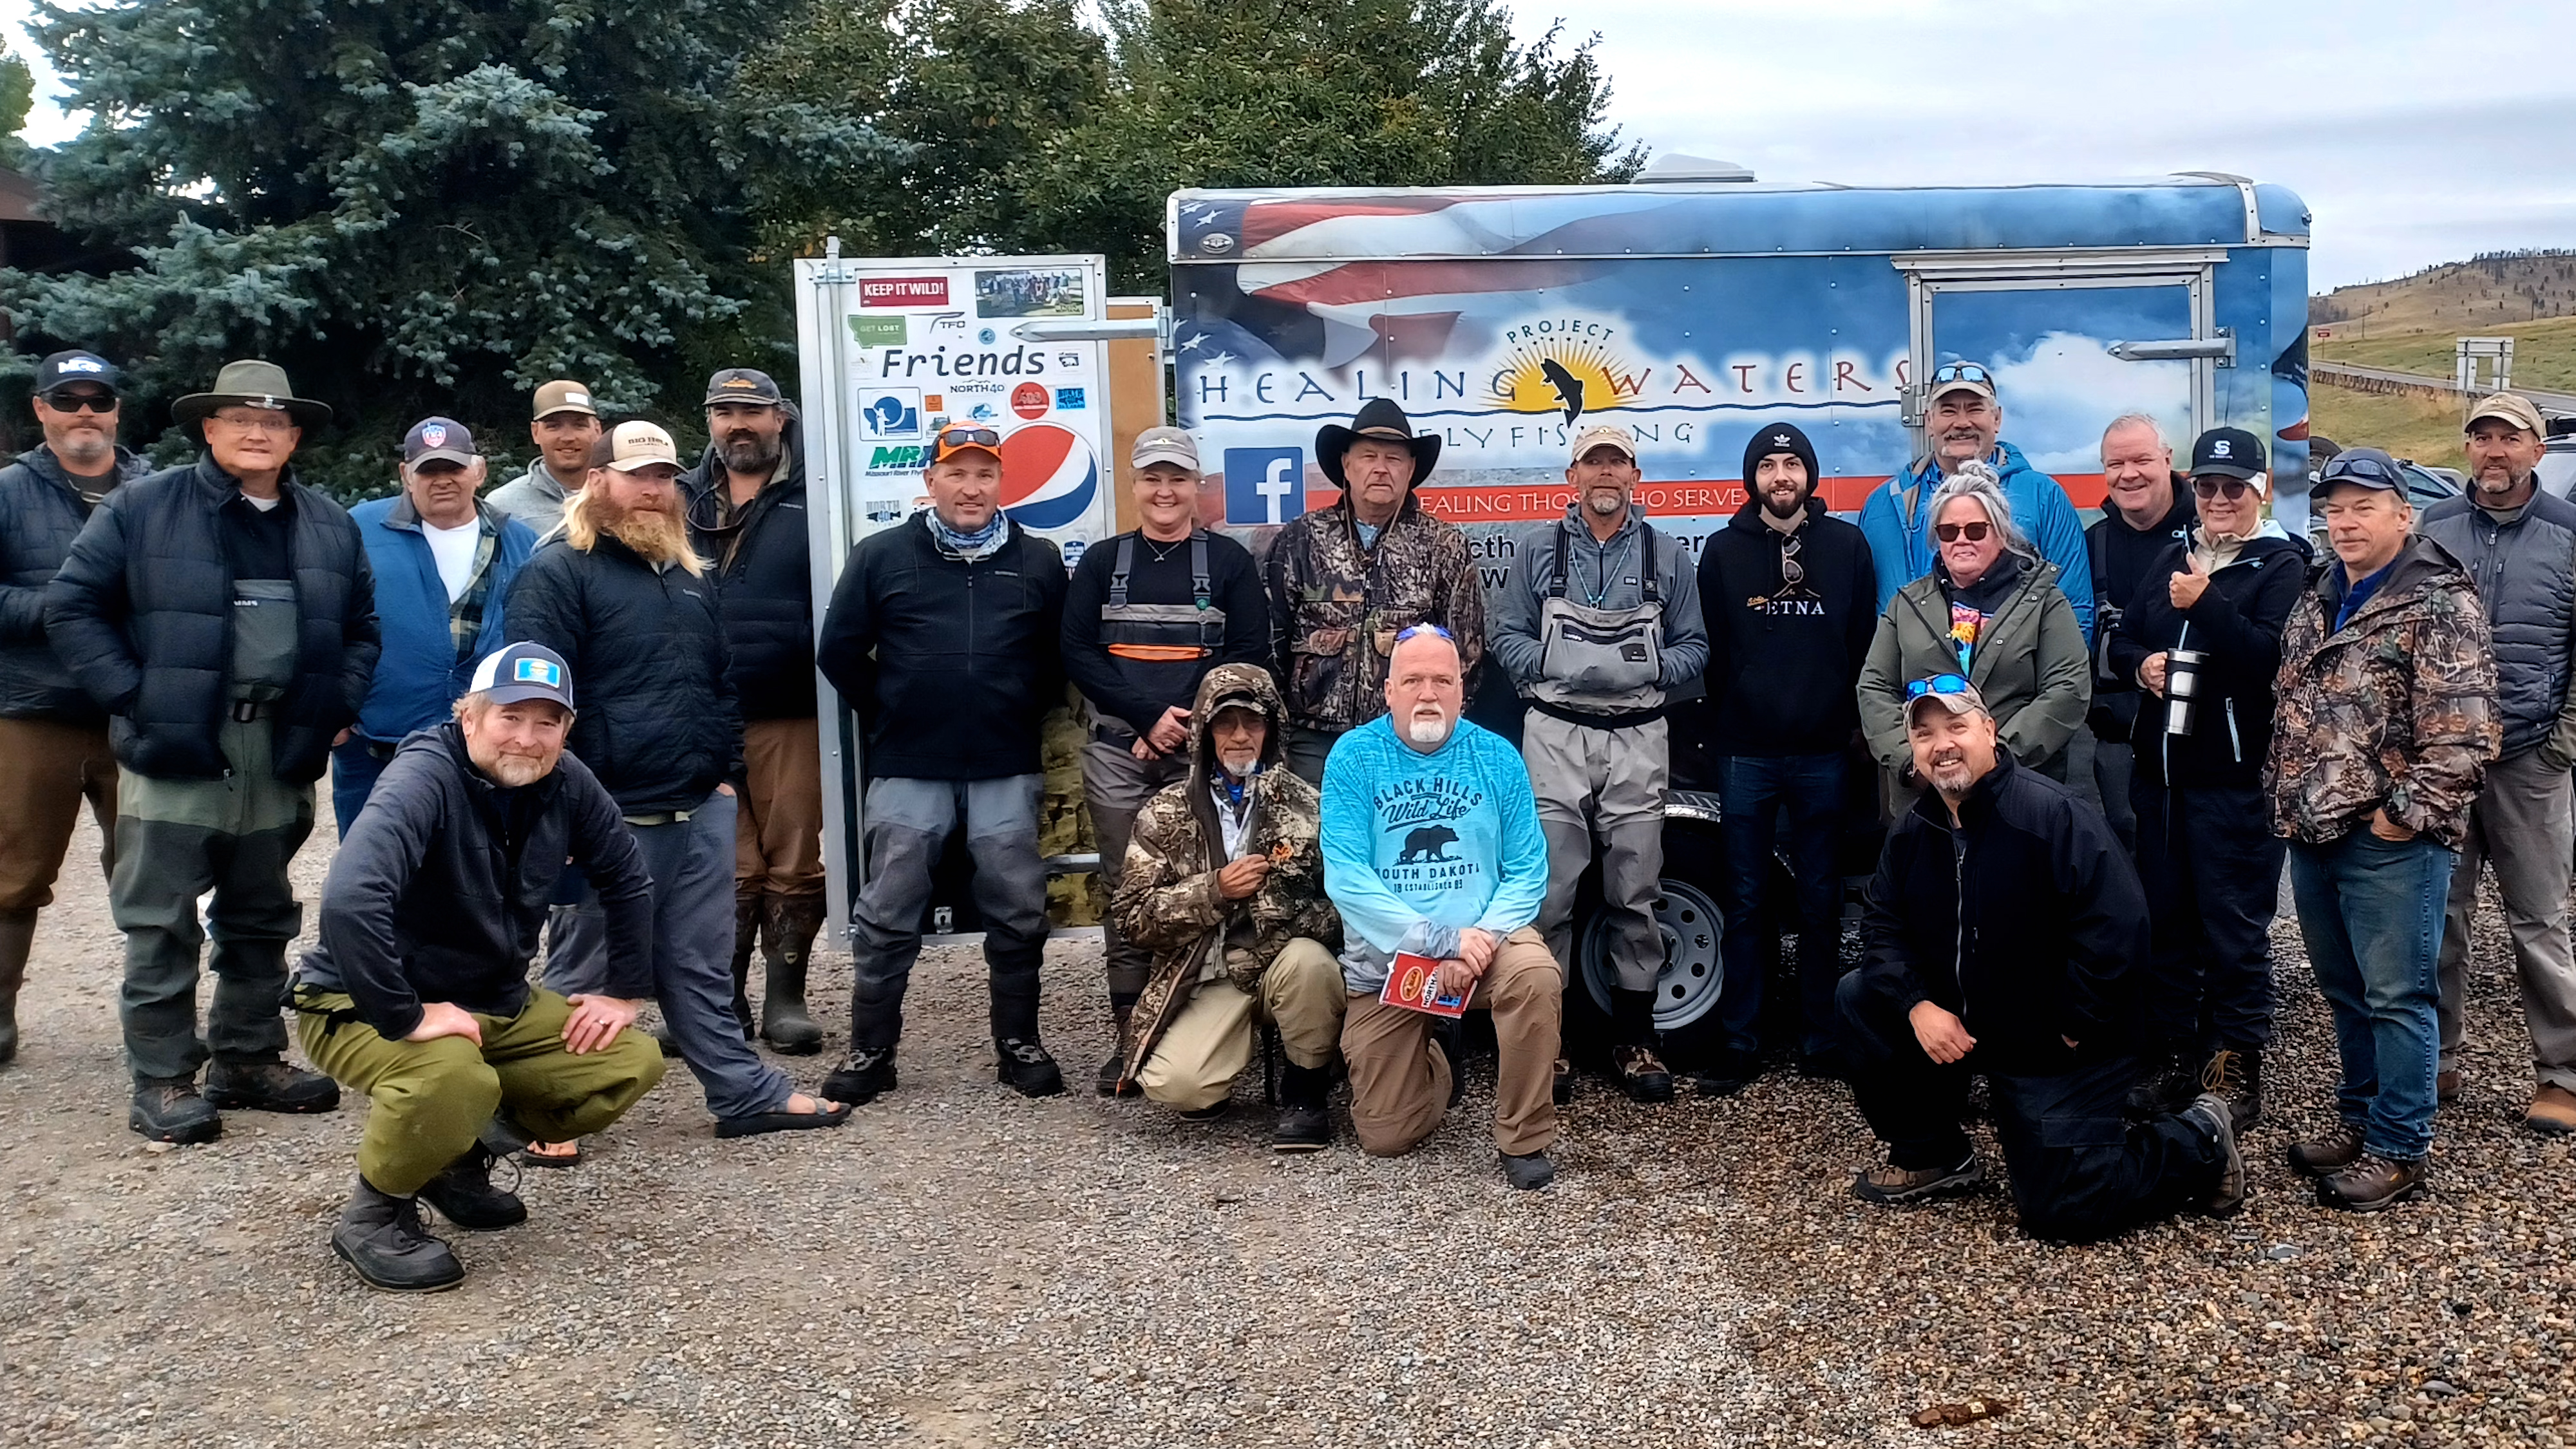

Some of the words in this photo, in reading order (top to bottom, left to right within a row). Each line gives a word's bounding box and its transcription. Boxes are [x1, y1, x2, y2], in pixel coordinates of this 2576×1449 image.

[864, 283, 893, 296] KEEP
[896, 283, 907, 296] IT
[909, 282, 944, 295] WILD!
[1506, 319, 1613, 344] PROJECT
[882, 345, 1045, 377] Friends
[1200, 368, 1516, 403] HEALING
[1602, 359, 1909, 395] WATERS
[866, 500, 900, 513] NORTH
[1420, 493, 1511, 514] EALING
[1630, 489, 1667, 507] HO
[1674, 488, 1743, 507] SERVE
[1373, 779, 1425, 811] BLACK
[1434, 777, 1482, 806] HILLS
[1382, 799, 1430, 824] Wild
[1430, 796, 1472, 820] Life
